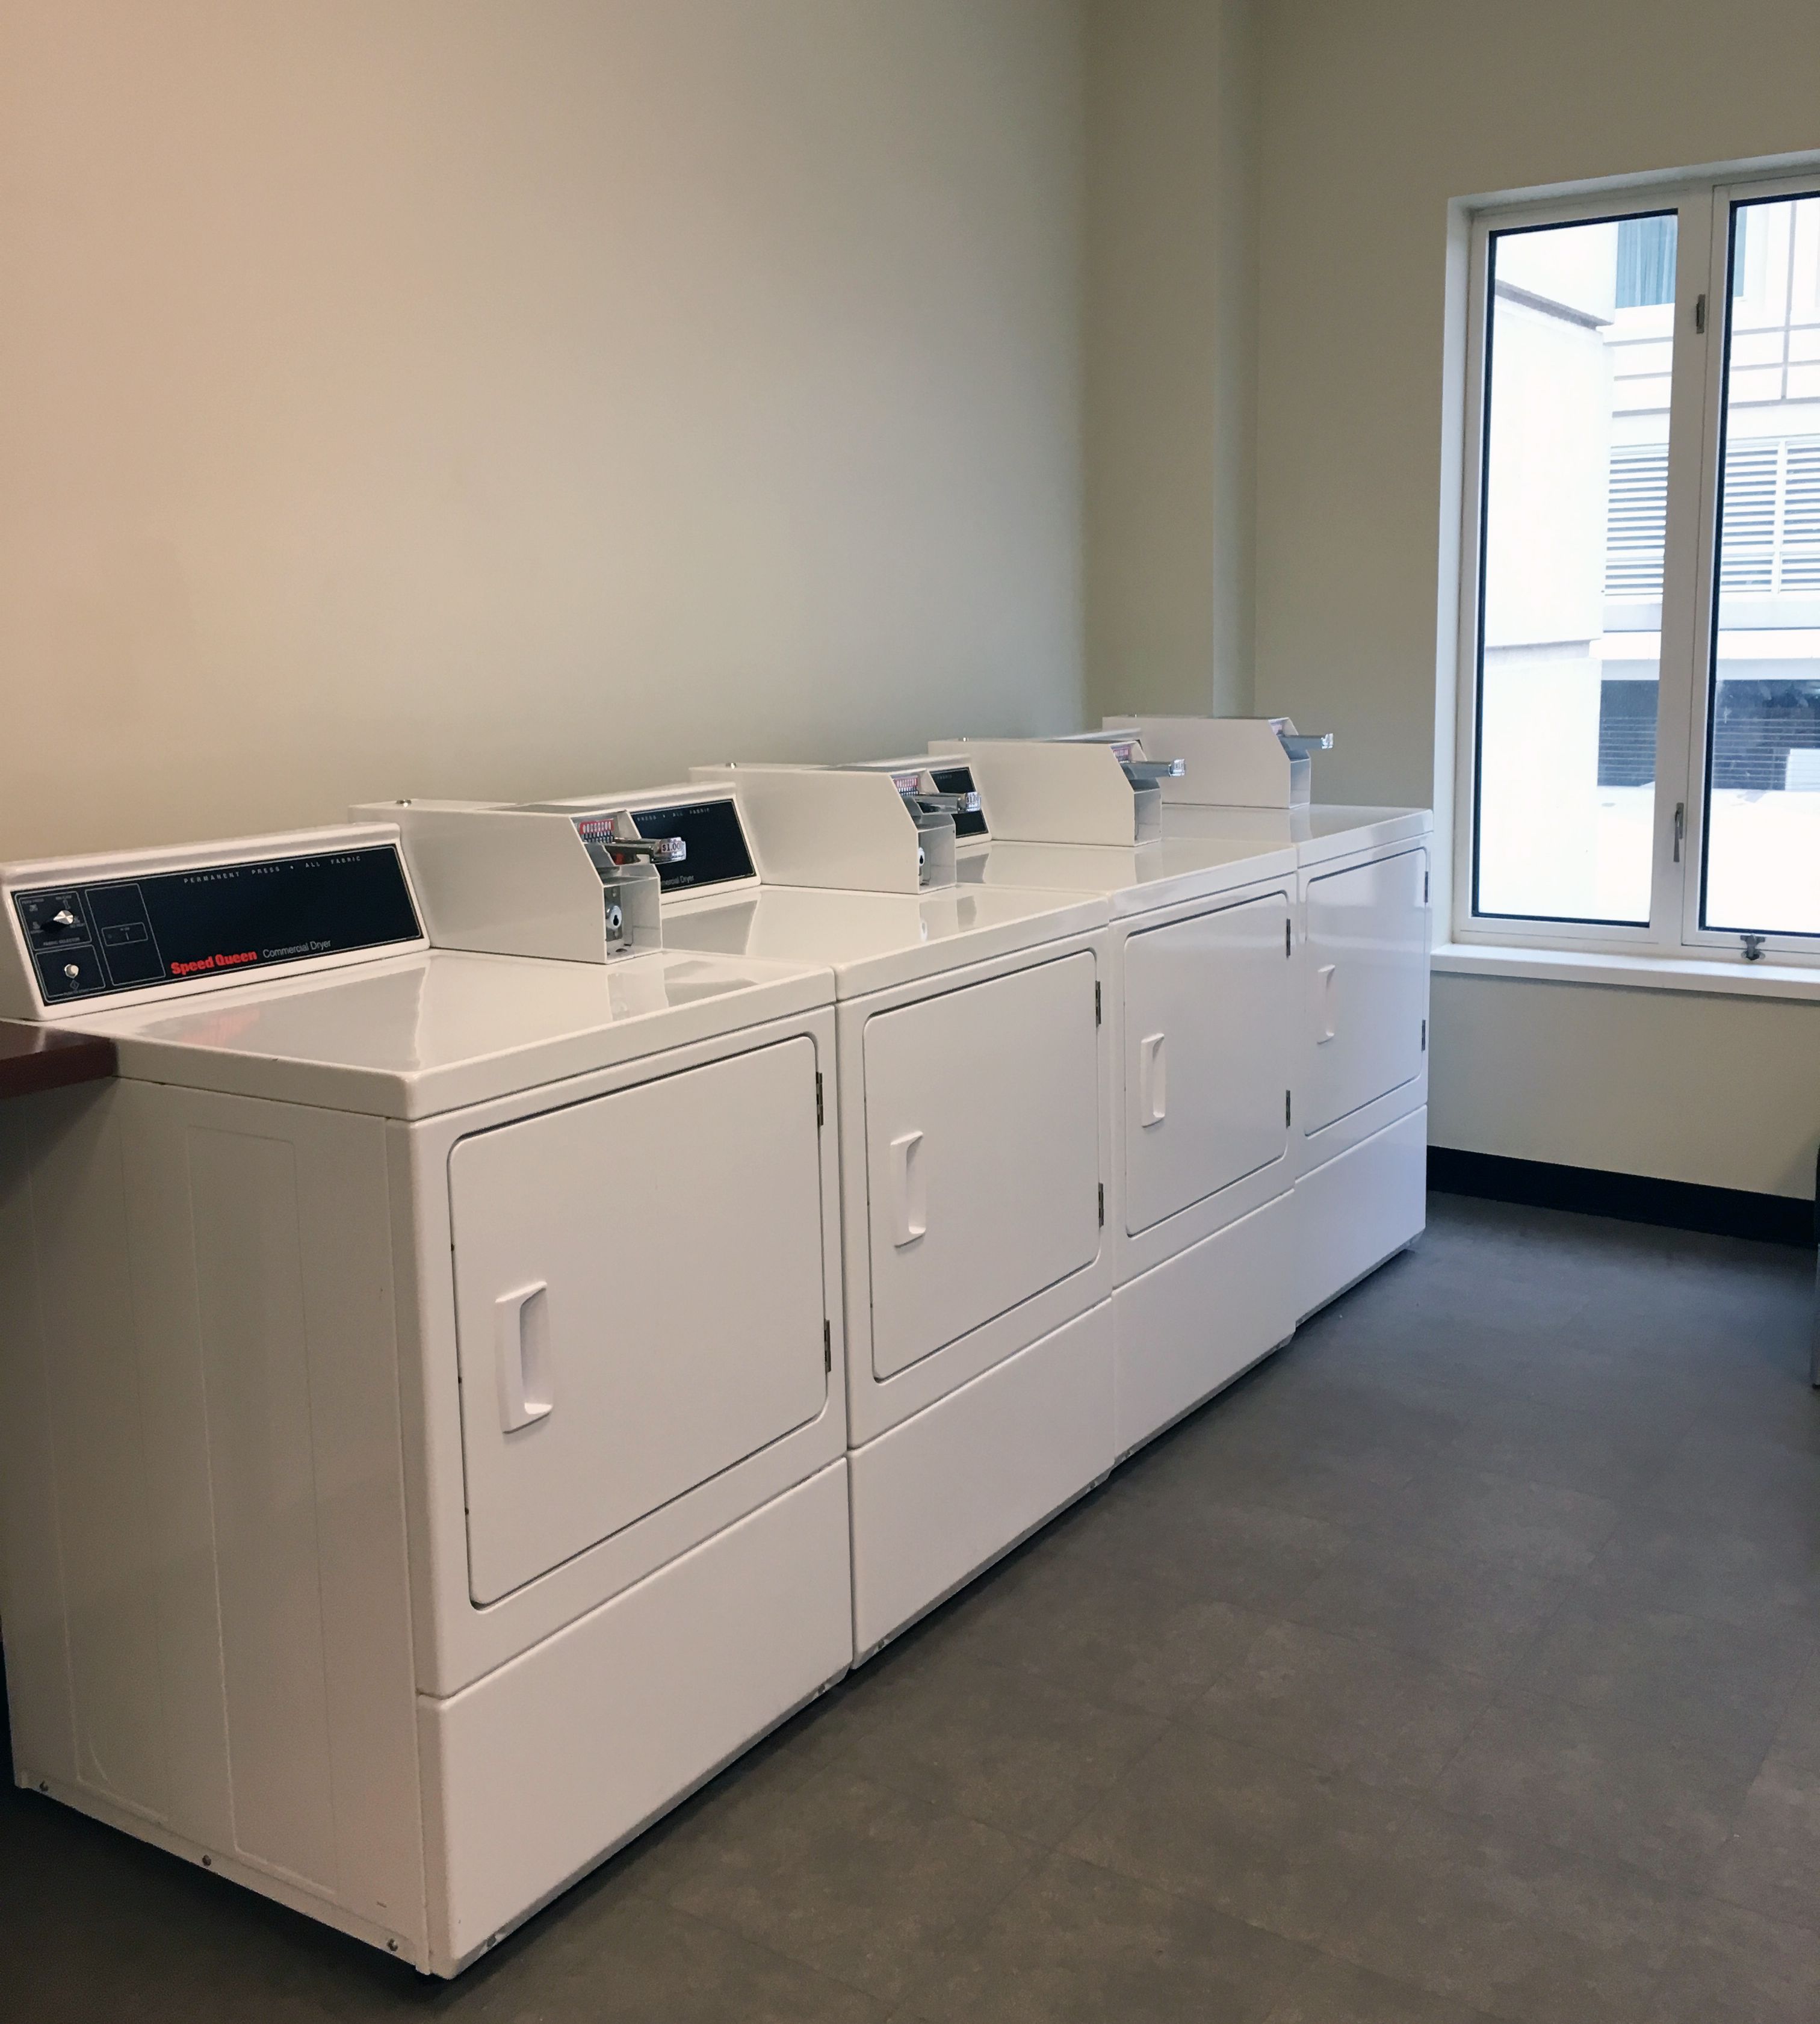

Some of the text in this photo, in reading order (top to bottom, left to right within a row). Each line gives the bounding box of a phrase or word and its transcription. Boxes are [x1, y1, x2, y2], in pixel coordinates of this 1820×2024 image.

[662, 842, 681, 852] $1.00
[184, 871, 240, 884] PERMANENT
[252, 867, 280, 875] PRESS
[330, 855, 361, 865] FABRIC
[262, 939, 331, 959] Commercial Dryer
[170, 950, 258, 976] Speed Queen
